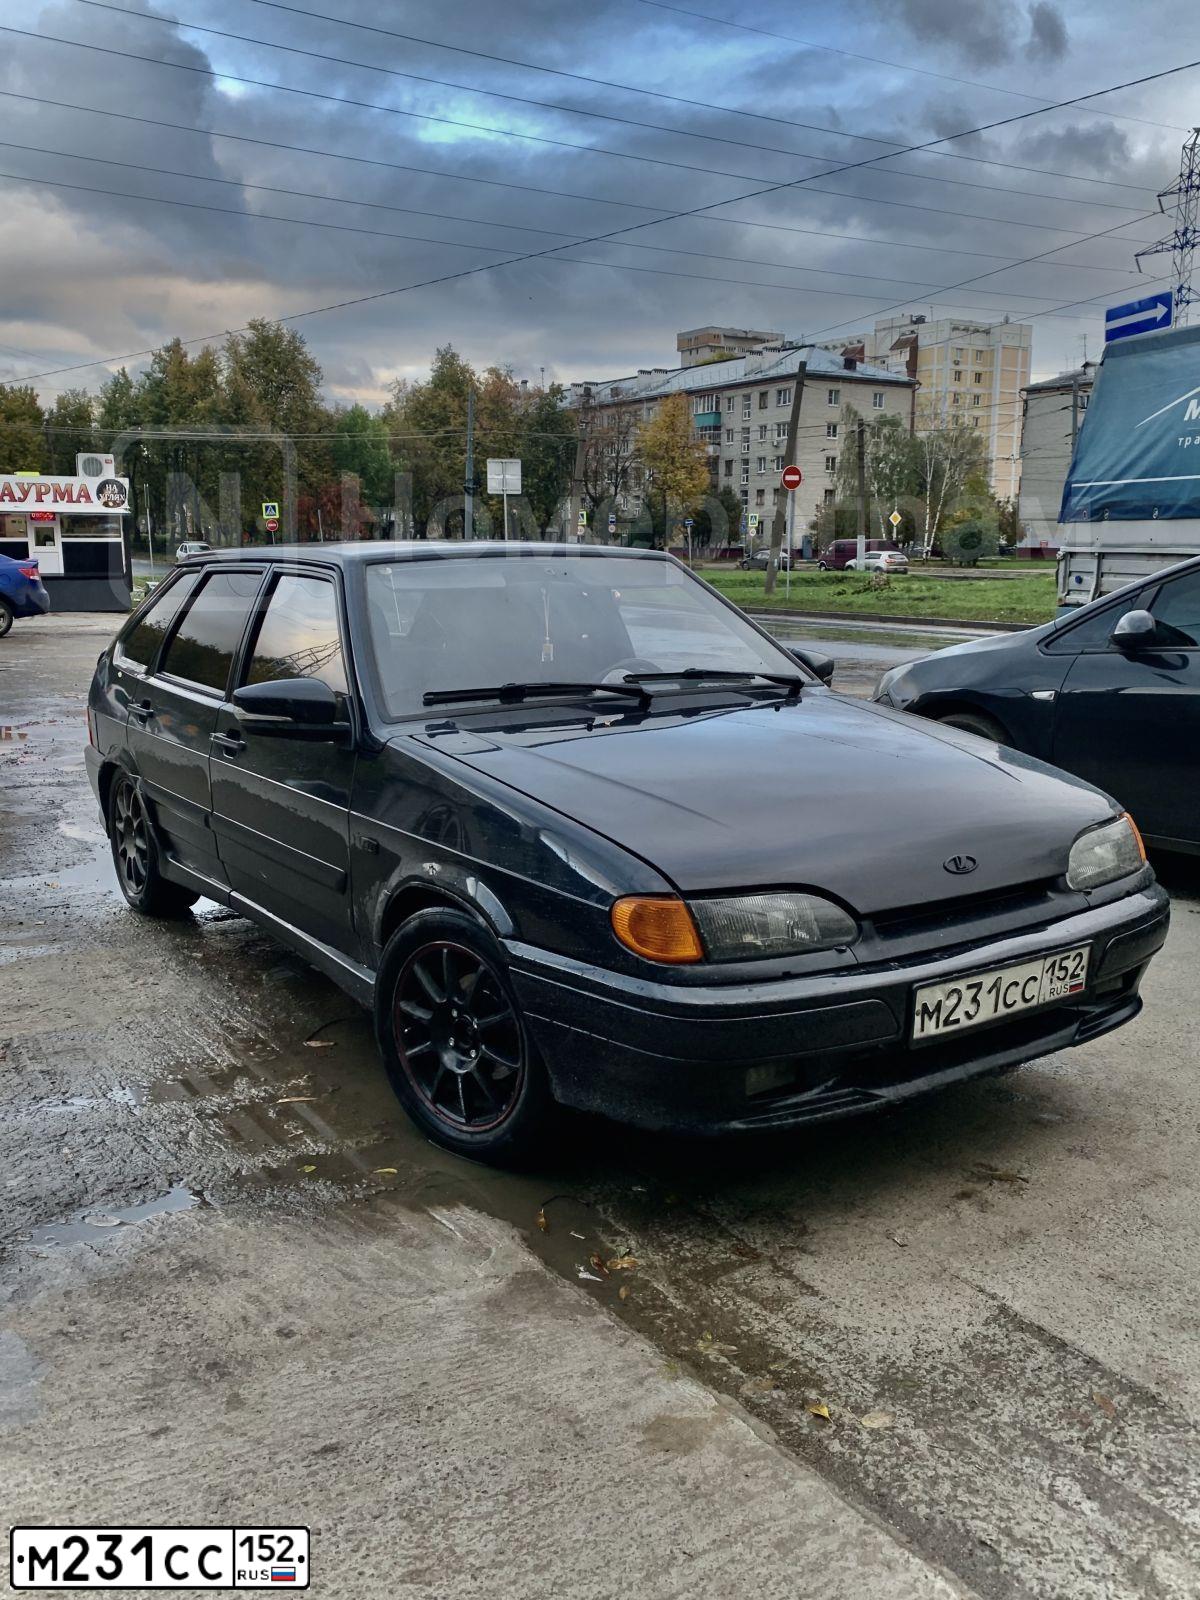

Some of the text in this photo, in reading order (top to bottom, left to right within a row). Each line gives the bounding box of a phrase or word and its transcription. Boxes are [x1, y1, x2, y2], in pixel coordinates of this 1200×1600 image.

[105, 484, 118, 493] НА
[99, 493, 125, 501] УГЛЯХ
[1045, 951, 1085, 984] 152
[1049, 983, 1069, 997] RUS
